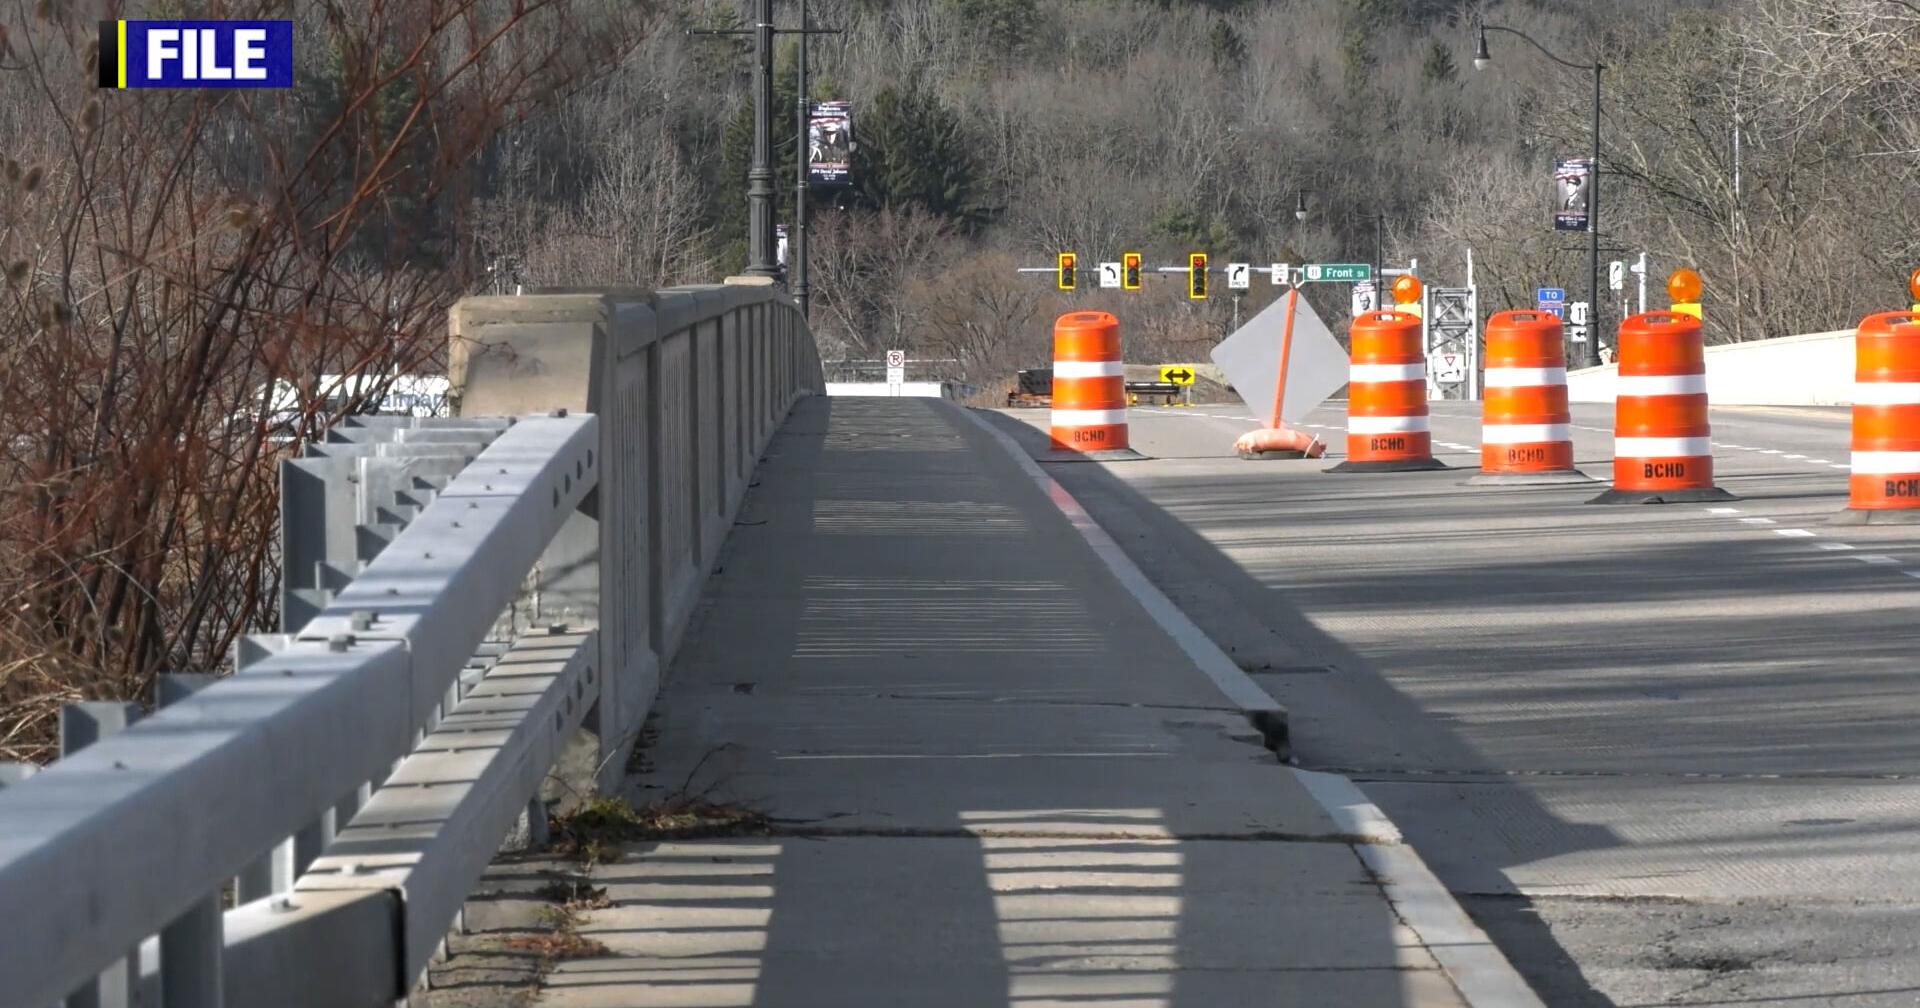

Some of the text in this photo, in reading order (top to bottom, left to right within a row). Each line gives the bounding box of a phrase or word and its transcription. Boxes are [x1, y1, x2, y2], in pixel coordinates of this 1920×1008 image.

[1326, 268, 1353, 278] Front
[1545, 291, 1558, 299] TO
[1074, 430, 1105, 442] BCHD
[1371, 438, 1405, 451] BCHD
[1508, 447, 1545, 462] BCHD
[1644, 462, 1684, 478] BCHD
[1885, 479, 1920, 498] BCH
